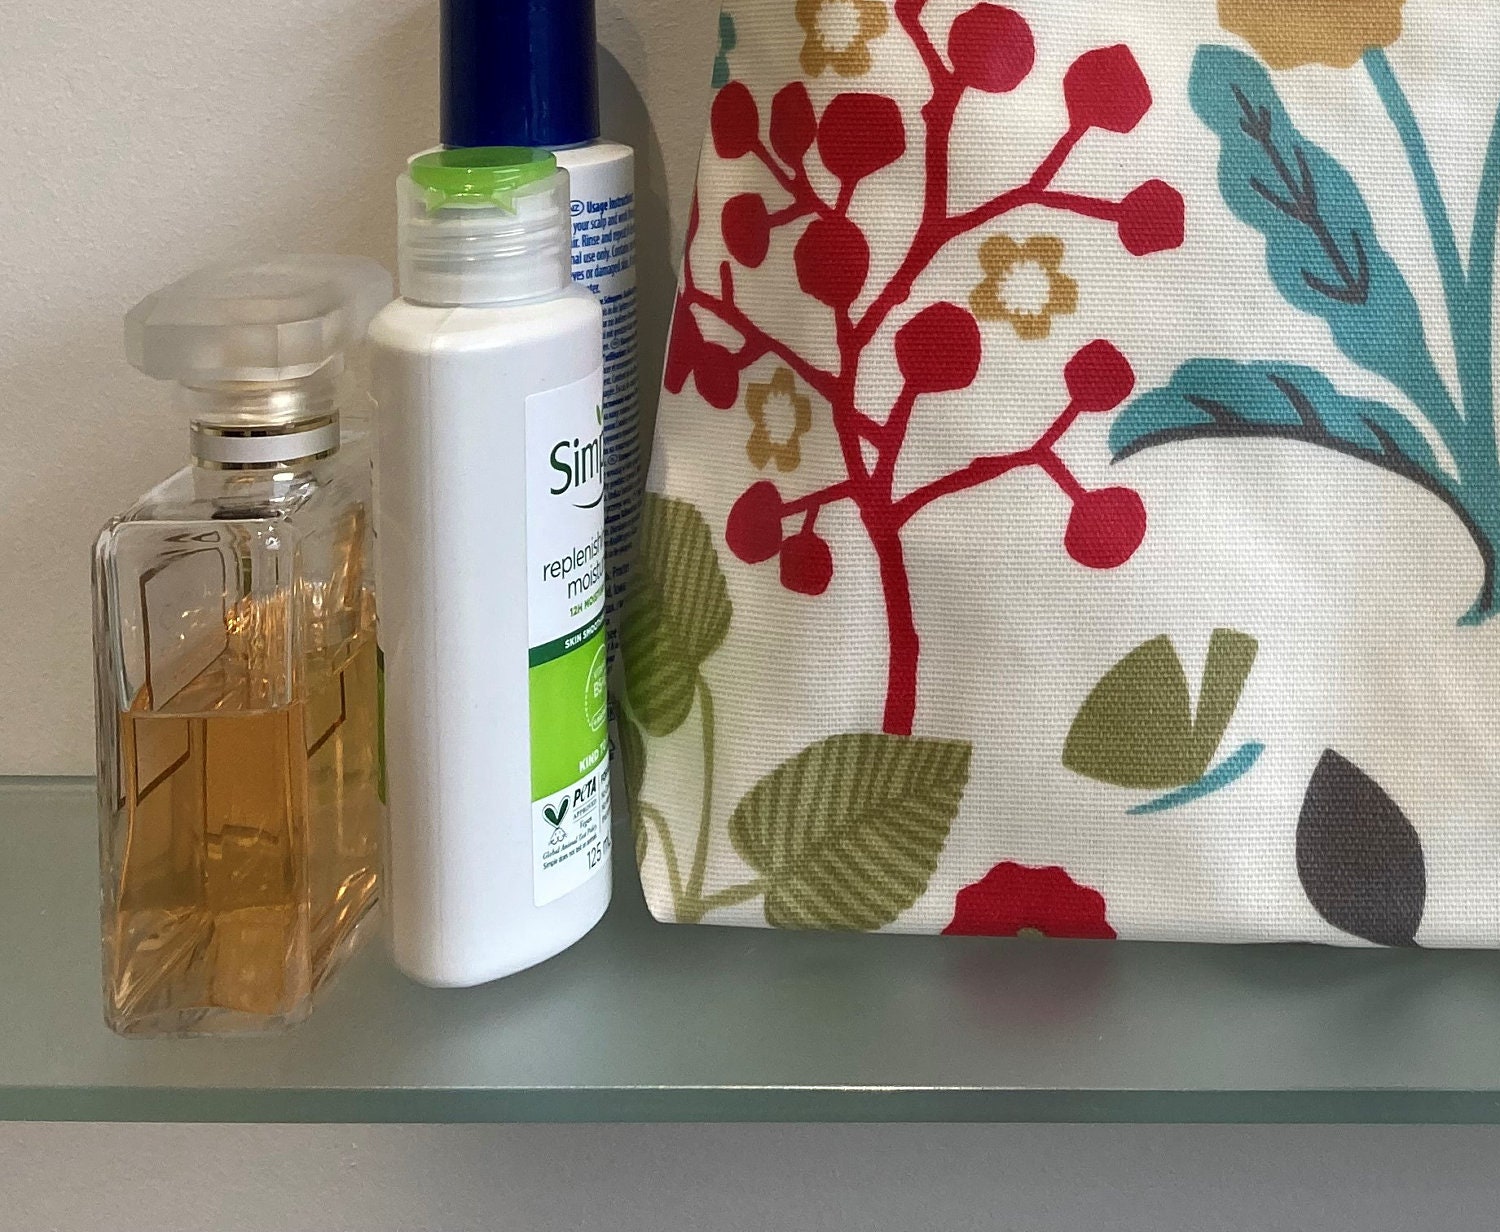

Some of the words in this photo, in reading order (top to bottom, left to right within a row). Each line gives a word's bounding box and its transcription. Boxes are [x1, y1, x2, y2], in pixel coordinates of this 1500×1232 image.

[573, 220, 589, 235] your
[581, 233, 600, 248] Rinse
[583, 251, 596, 263] use
[564, 633, 582, 649] SKIN
[579, 748, 599, 774] KIND
[586, 840, 602, 871] 125
